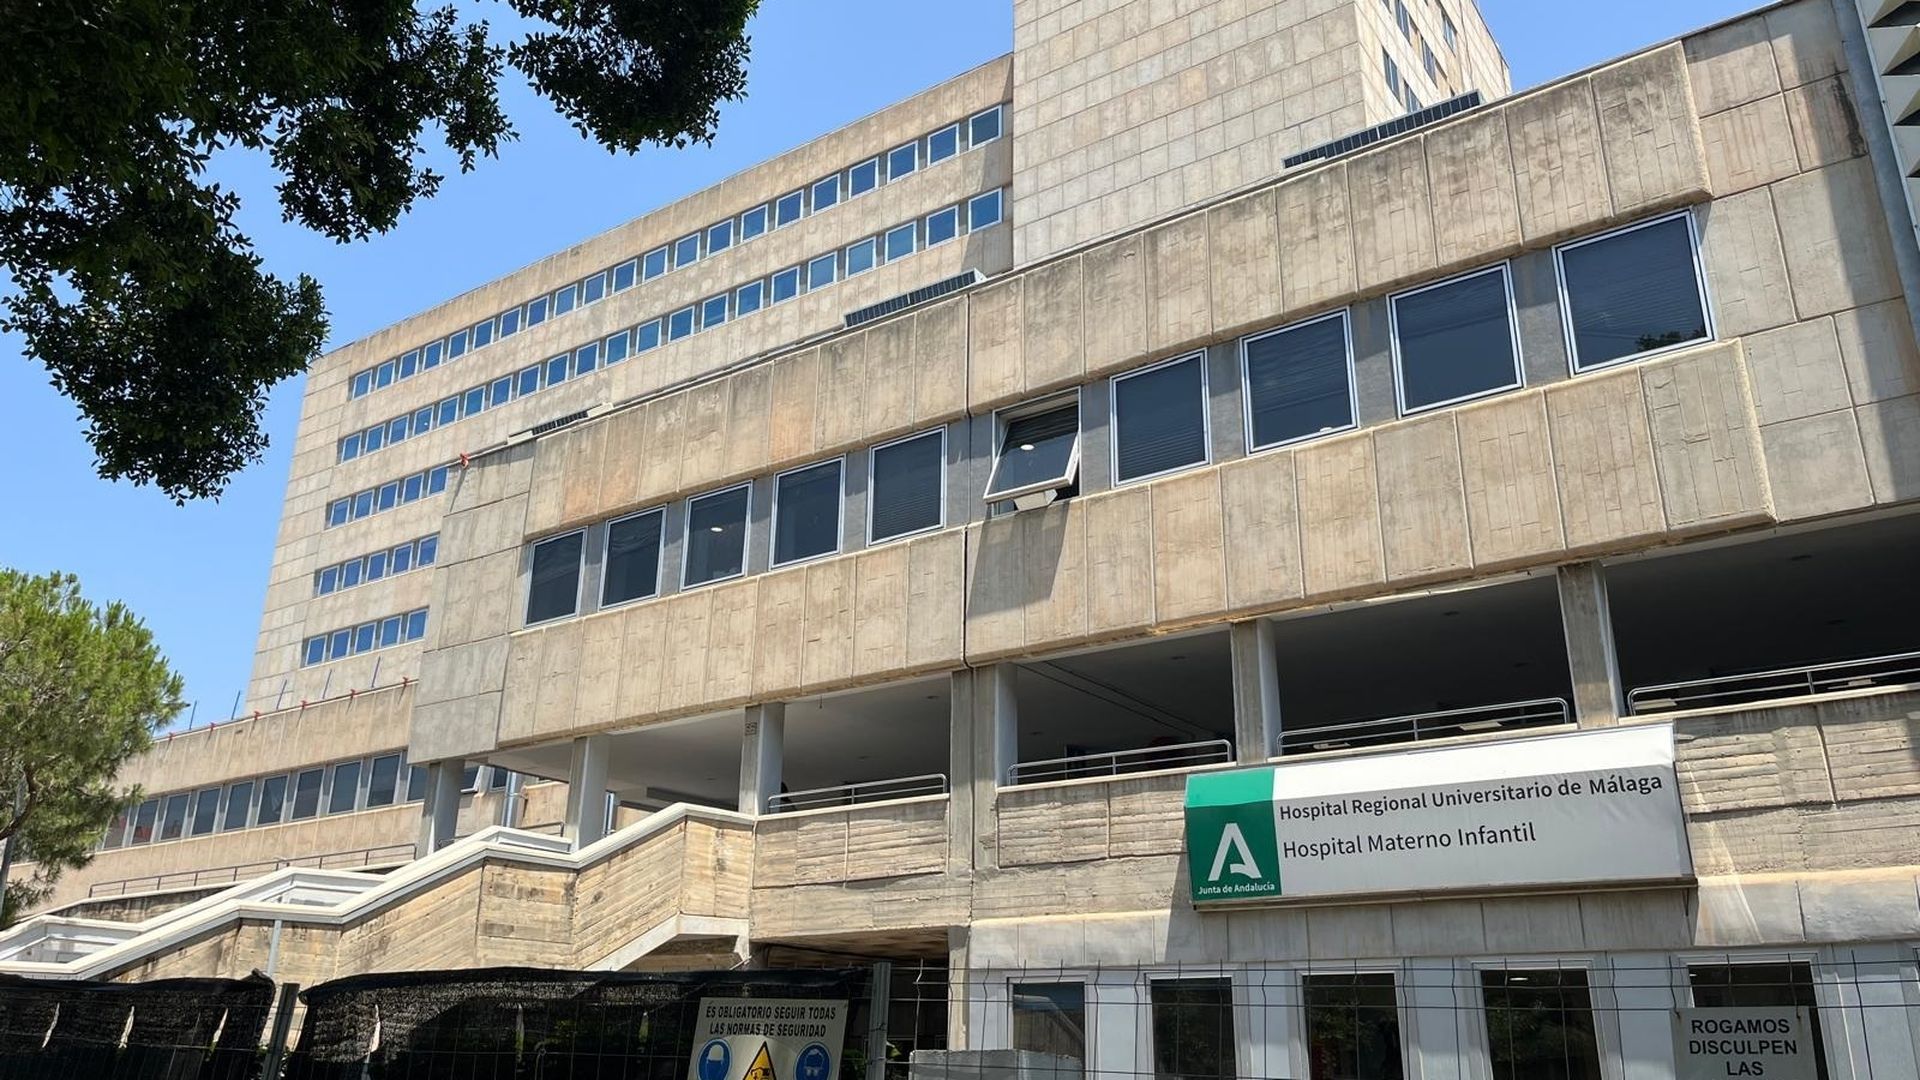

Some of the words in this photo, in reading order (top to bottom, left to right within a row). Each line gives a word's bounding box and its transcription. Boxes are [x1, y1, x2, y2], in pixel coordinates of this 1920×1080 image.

[1280, 800, 1348, 821] Hospital
[1352, 793, 1427, 816] Regional
[1432, 782, 1553, 809] Universitario
[1558, 780, 1582, 796] de
[1589, 774, 1663, 795] Málaga
[1283, 835, 1363, 860] Hospital
[1368, 832, 1452, 853] Materno
[1458, 822, 1537, 847] Infantil
[1198, 885, 1221, 895] Junta
[1222, 884, 1232, 893] de
[1234, 881, 1275, 893] Andalucía
[706, 1006, 716, 1018] ES
[718, 1006, 772, 1020] OBLIGATORIO
[774, 1006, 806, 1020] SEGUIR
[808, 1007, 836, 1020] TODAS
[709, 1022, 725, 1035] LAS
[726, 1023, 761, 1036] NORMAS
[763, 1023, 775, 1036] DE
[777, 1024, 827, 1037] SEGURIDAD
[1691, 1018, 1790, 1034] ROGAMOS
[1689, 1040, 1797, 1055] DISCULPEN
[1726, 1061, 1764, 1076] LAS
